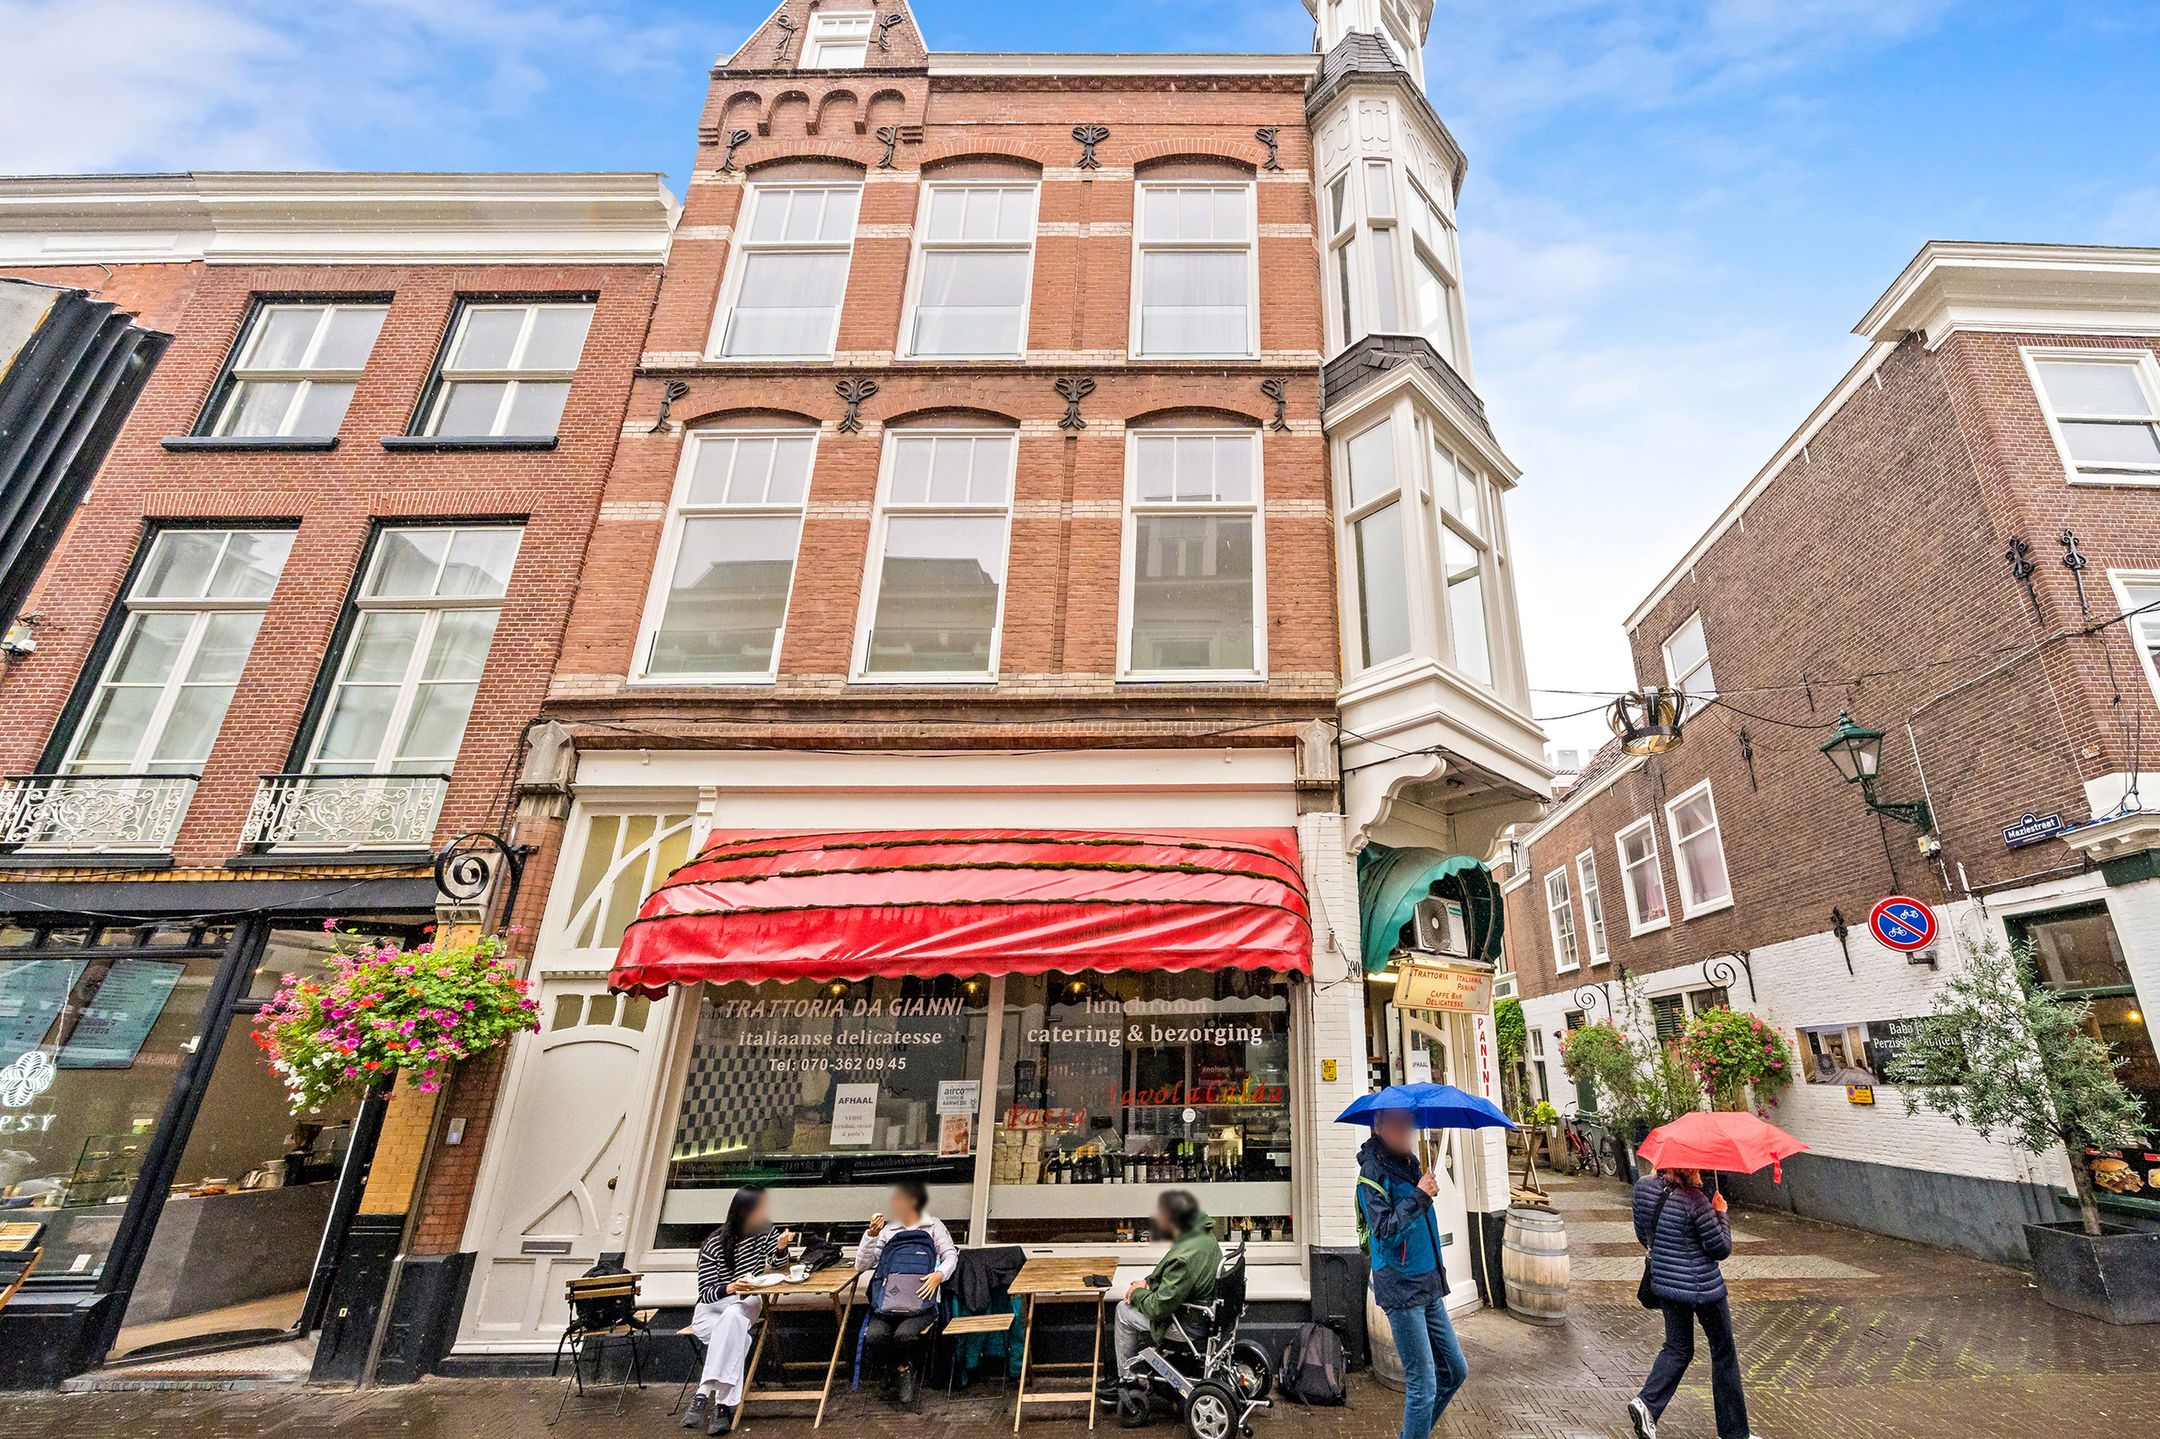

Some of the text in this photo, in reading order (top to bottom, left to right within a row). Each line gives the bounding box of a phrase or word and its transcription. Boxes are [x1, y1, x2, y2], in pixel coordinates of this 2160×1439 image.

[1413, 968, 1449, 981] TRATTORIA
[1456, 983, 1477, 992] PANINI
[1425, 998, 1465, 1008] DELICATESSE
[1450, 992, 1463, 1000] BAR
[725, 999, 845, 1018] TRATTORIA
[852, 998, 882, 1017] DA
[889, 997, 965, 1017] GIANNI
[1085, 996, 1209, 1015] lunchroom
[738, 1029, 942, 1047] italiaanse delicatesse
[1027, 1023, 1264, 1047] catering & bezorging
[768, 1057, 907, 1072] Tel: 070-362 09 45
[1478, 1017, 1490, 1097] PANINI
[838, 1096, 874, 1105] AFHAAL
